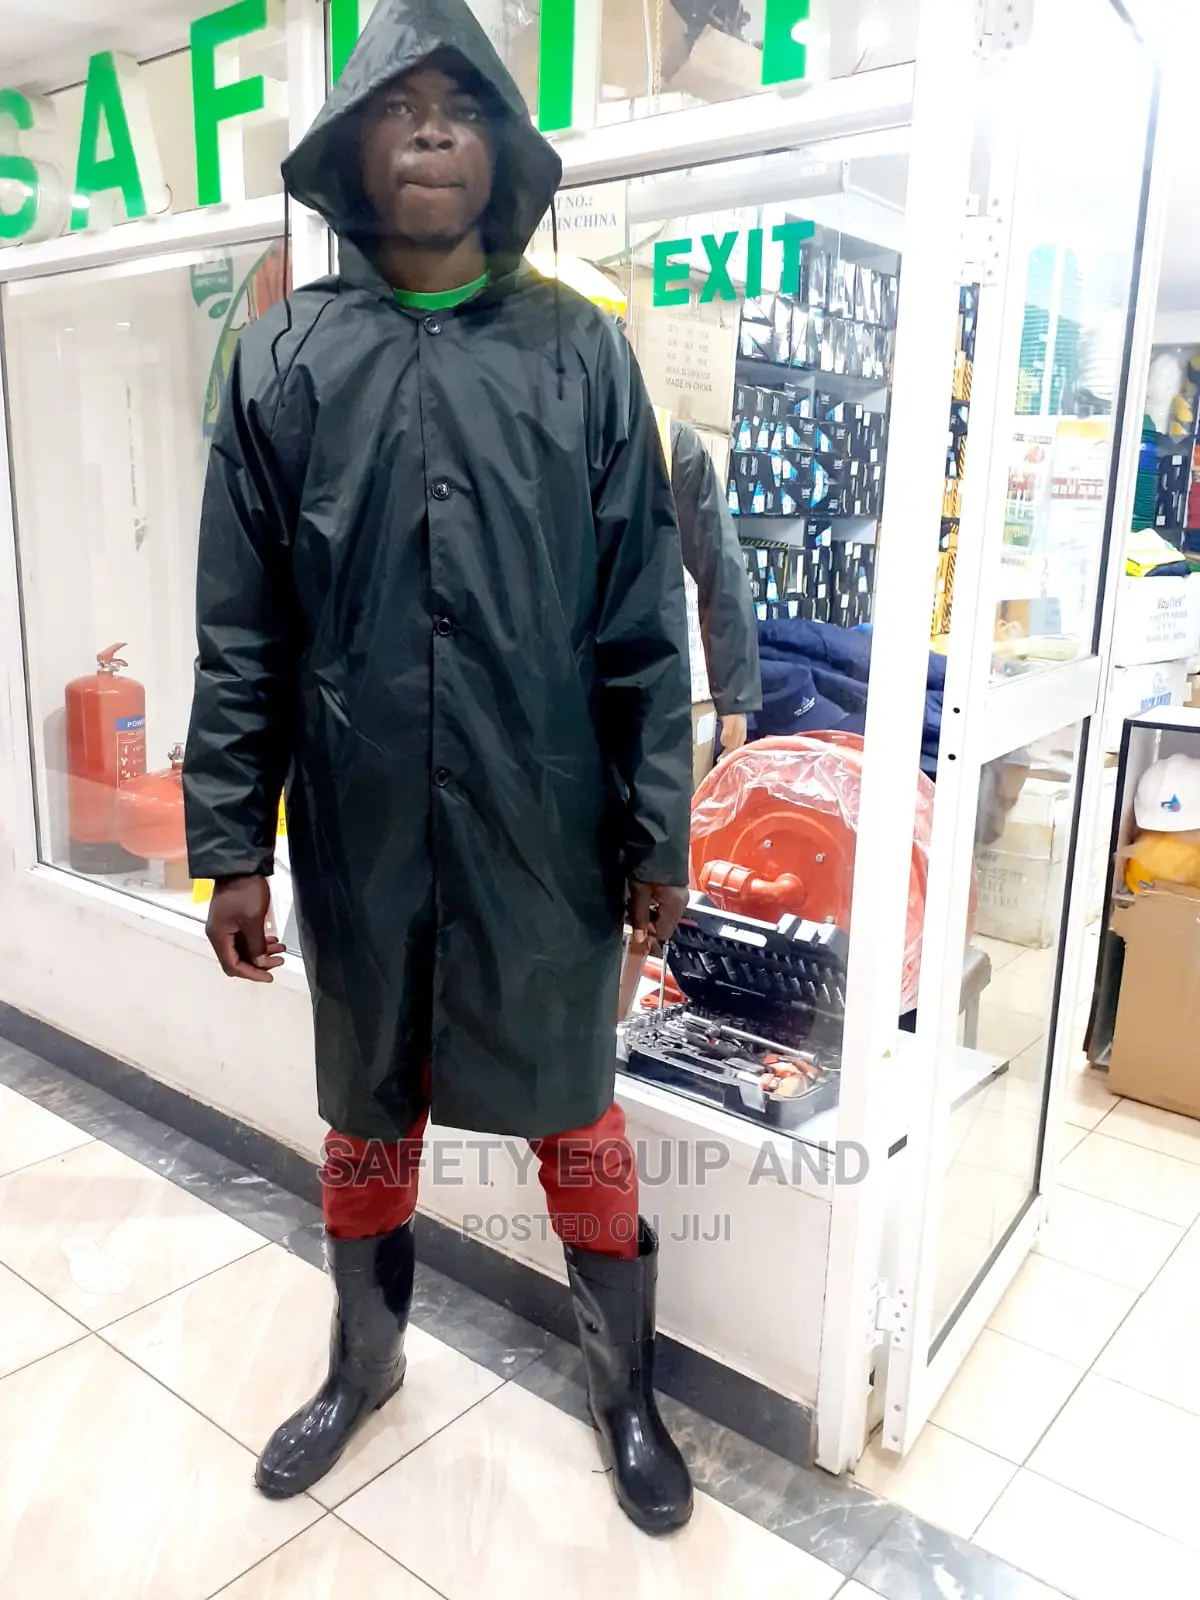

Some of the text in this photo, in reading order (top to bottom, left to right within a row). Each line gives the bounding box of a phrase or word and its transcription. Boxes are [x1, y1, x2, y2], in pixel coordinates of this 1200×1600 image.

[557, 216, 571, 231] IN
[574, 211, 617, 228] CHINA
[653, 220, 815, 307] EXIT
[665, 376, 684, 389] MADE
[692, 381, 712, 392] CHINA
